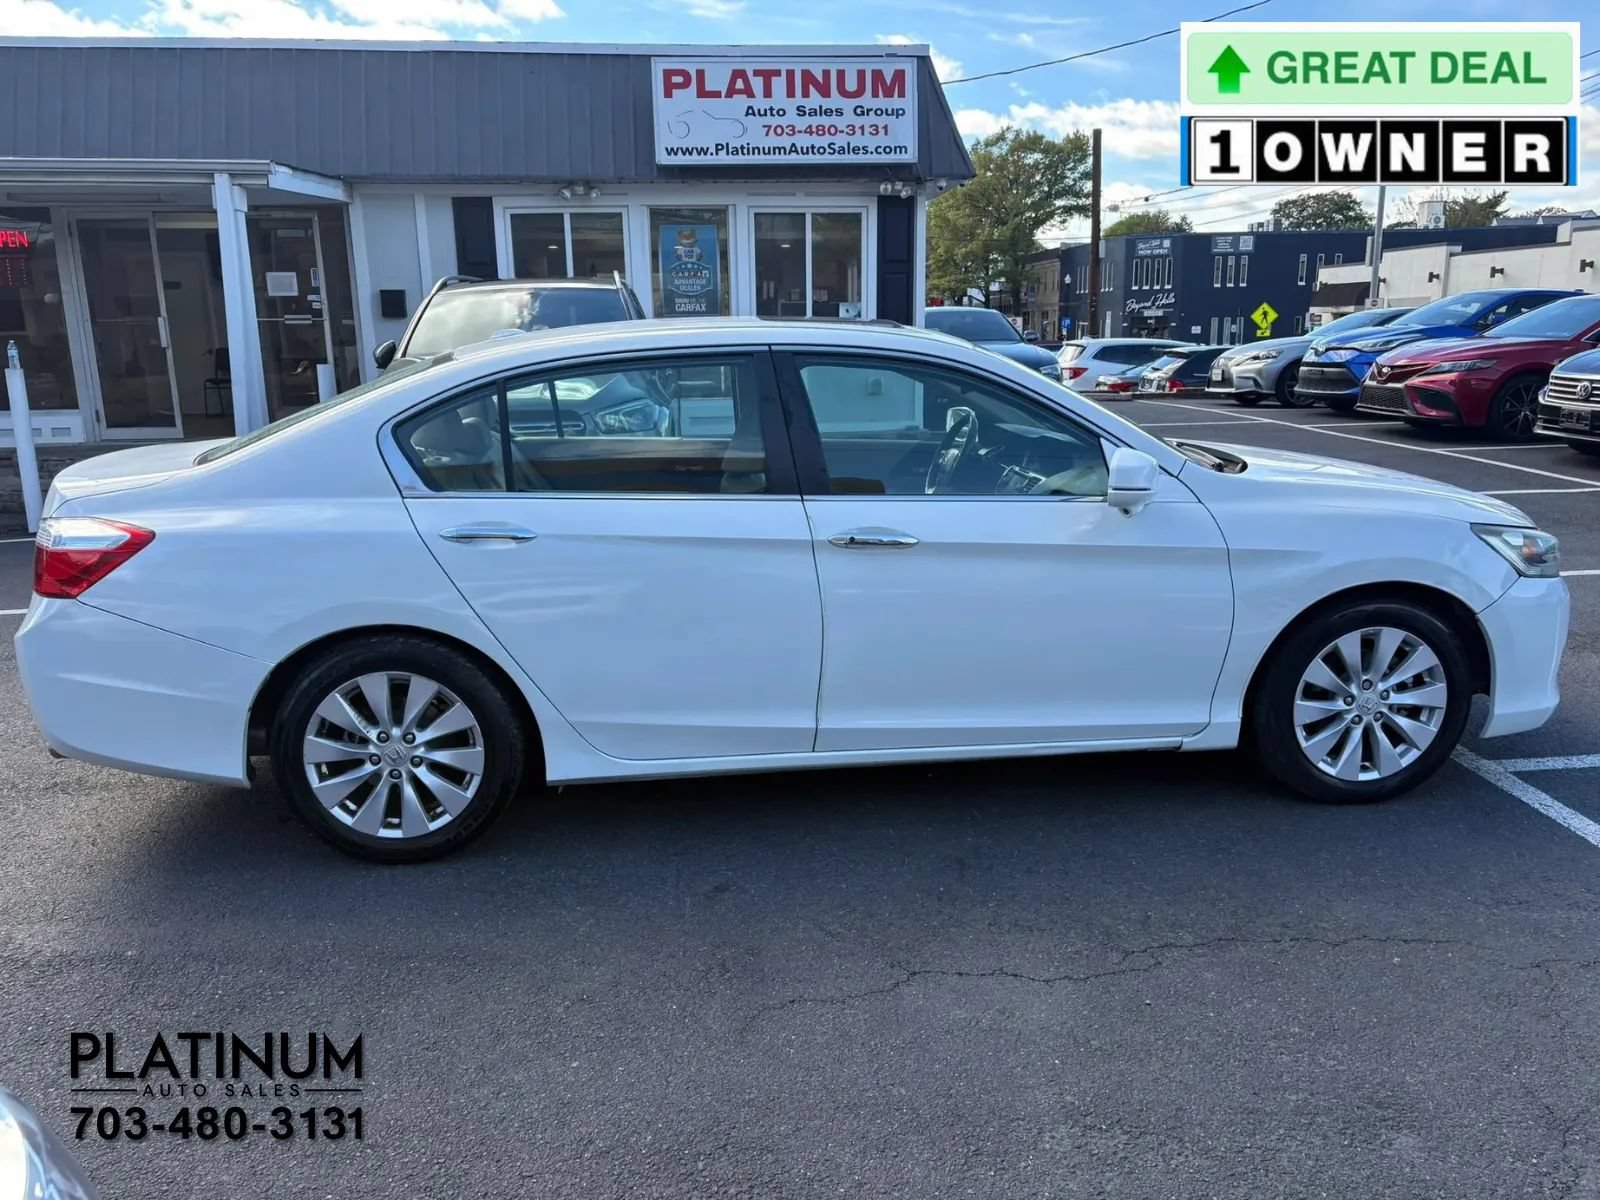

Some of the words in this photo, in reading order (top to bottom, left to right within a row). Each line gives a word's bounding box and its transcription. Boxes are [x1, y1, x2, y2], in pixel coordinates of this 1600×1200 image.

[662, 68, 906, 99] PLATINUM
[744, 105, 787, 117] Auto
[795, 104, 844, 117] Sales
[853, 104, 906, 119] Group
[761, 123, 890, 137] 703-480-3131
[664, 141, 908, 157] www.PlatinumAutoSales.com
[675, 303, 706, 311] CARFAX
